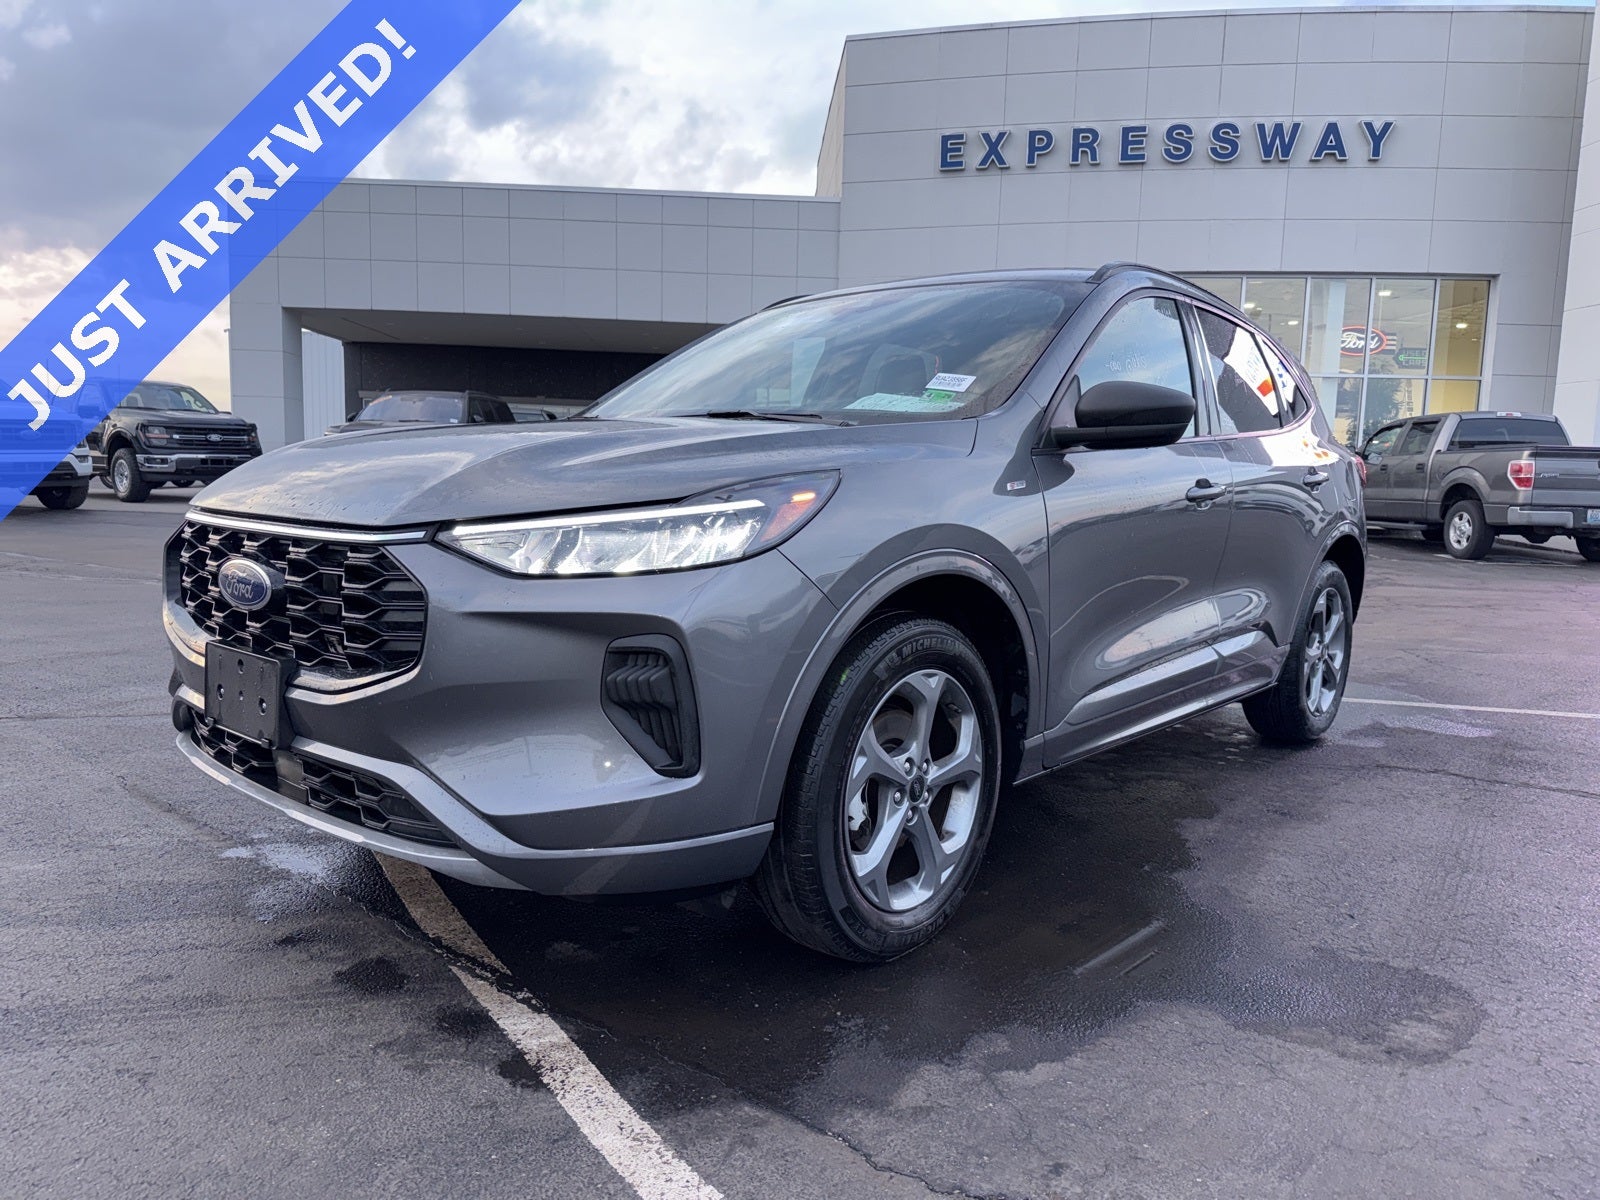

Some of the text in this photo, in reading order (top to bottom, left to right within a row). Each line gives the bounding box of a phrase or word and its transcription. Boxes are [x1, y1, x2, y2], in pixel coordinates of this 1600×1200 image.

[939, 120, 1396, 172] EXPRESSWAY
[226, 568, 254, 599] Ford
[901, 637, 956, 659] MICHELIN
